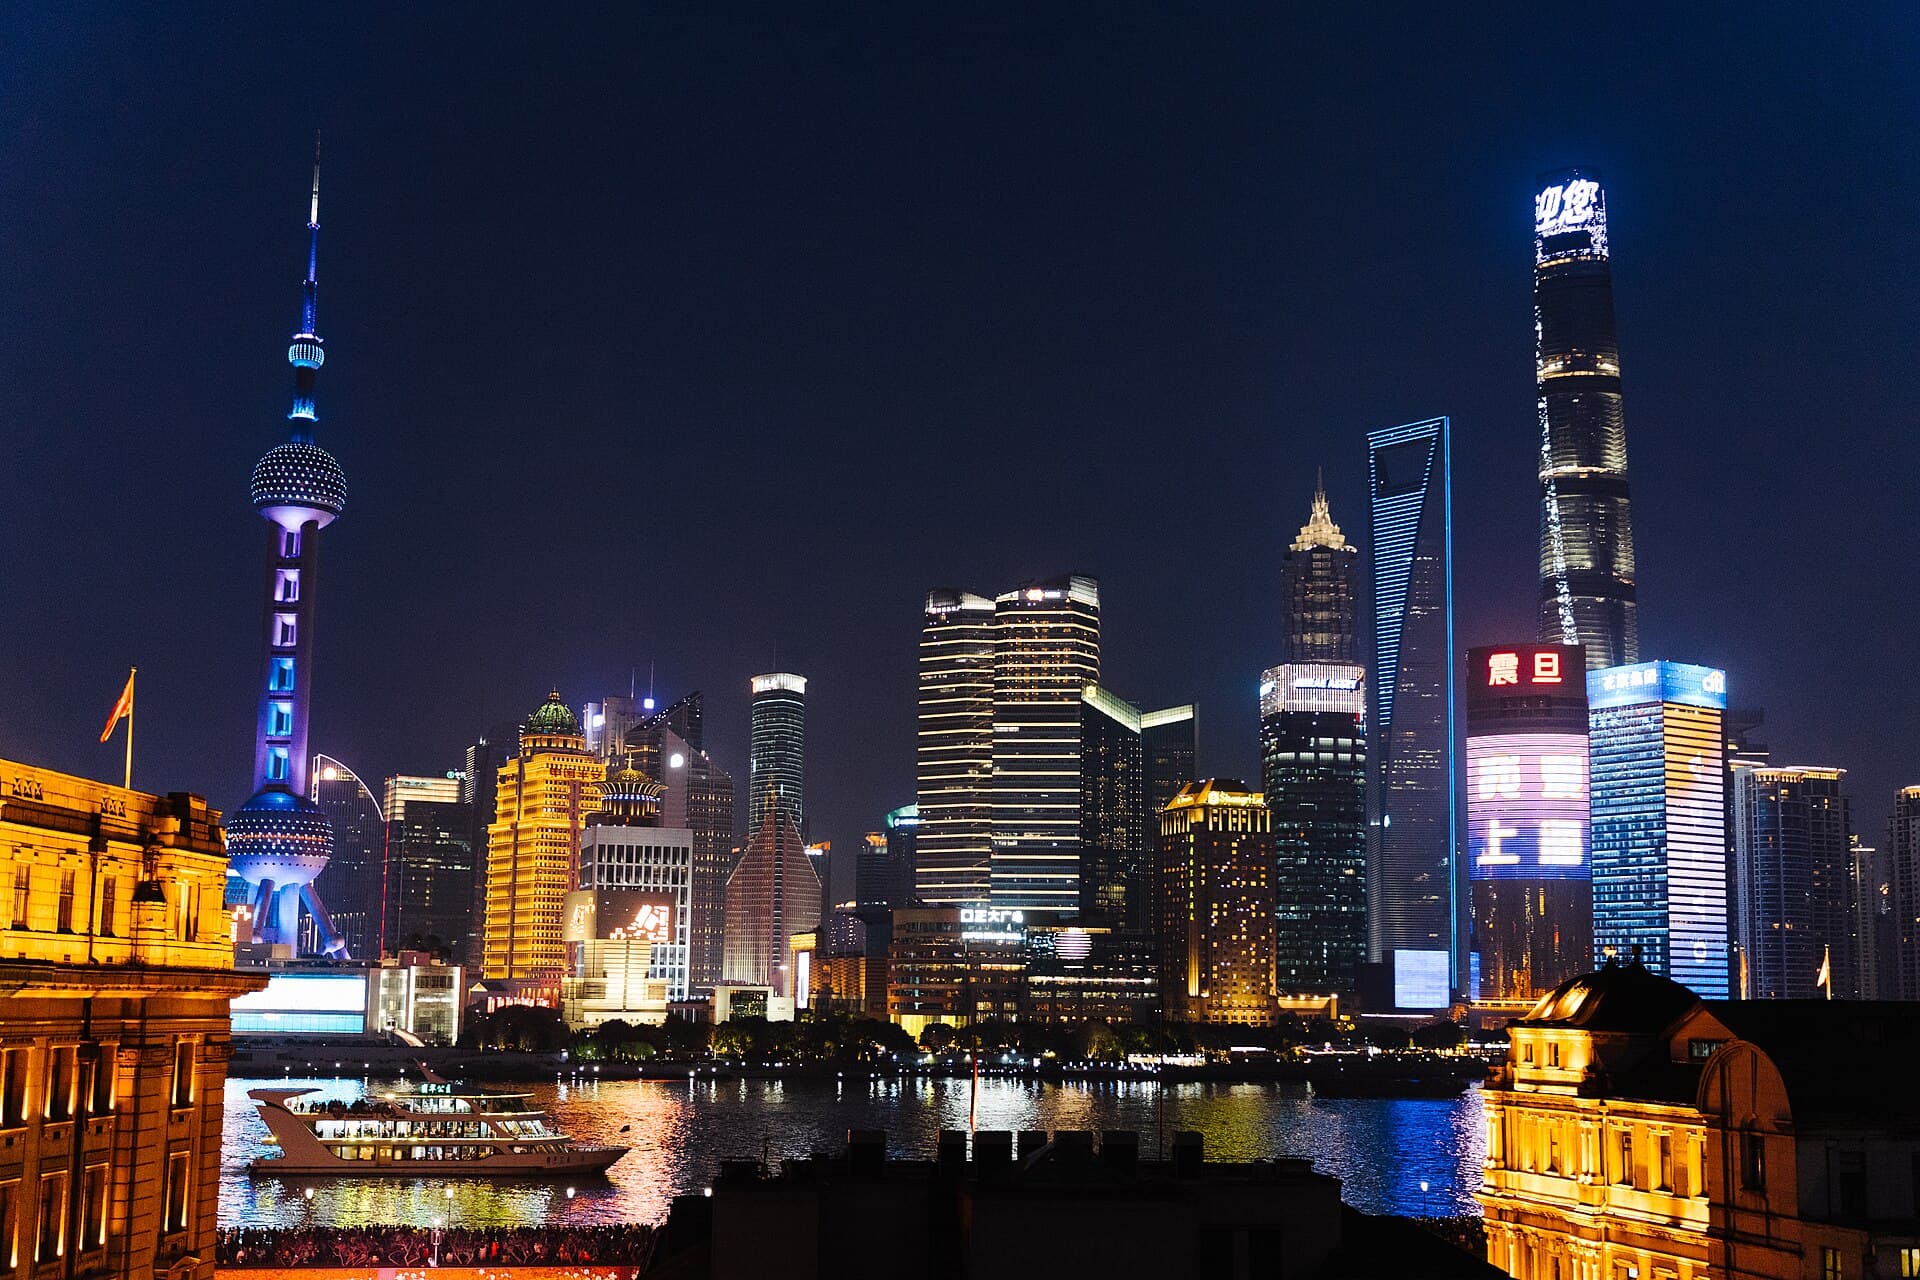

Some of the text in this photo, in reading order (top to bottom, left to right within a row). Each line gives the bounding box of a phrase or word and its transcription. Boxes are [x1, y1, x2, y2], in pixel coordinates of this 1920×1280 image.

[1488, 652, 1562, 686] 震旦
[549, 767, 602, 780] 中国平安
